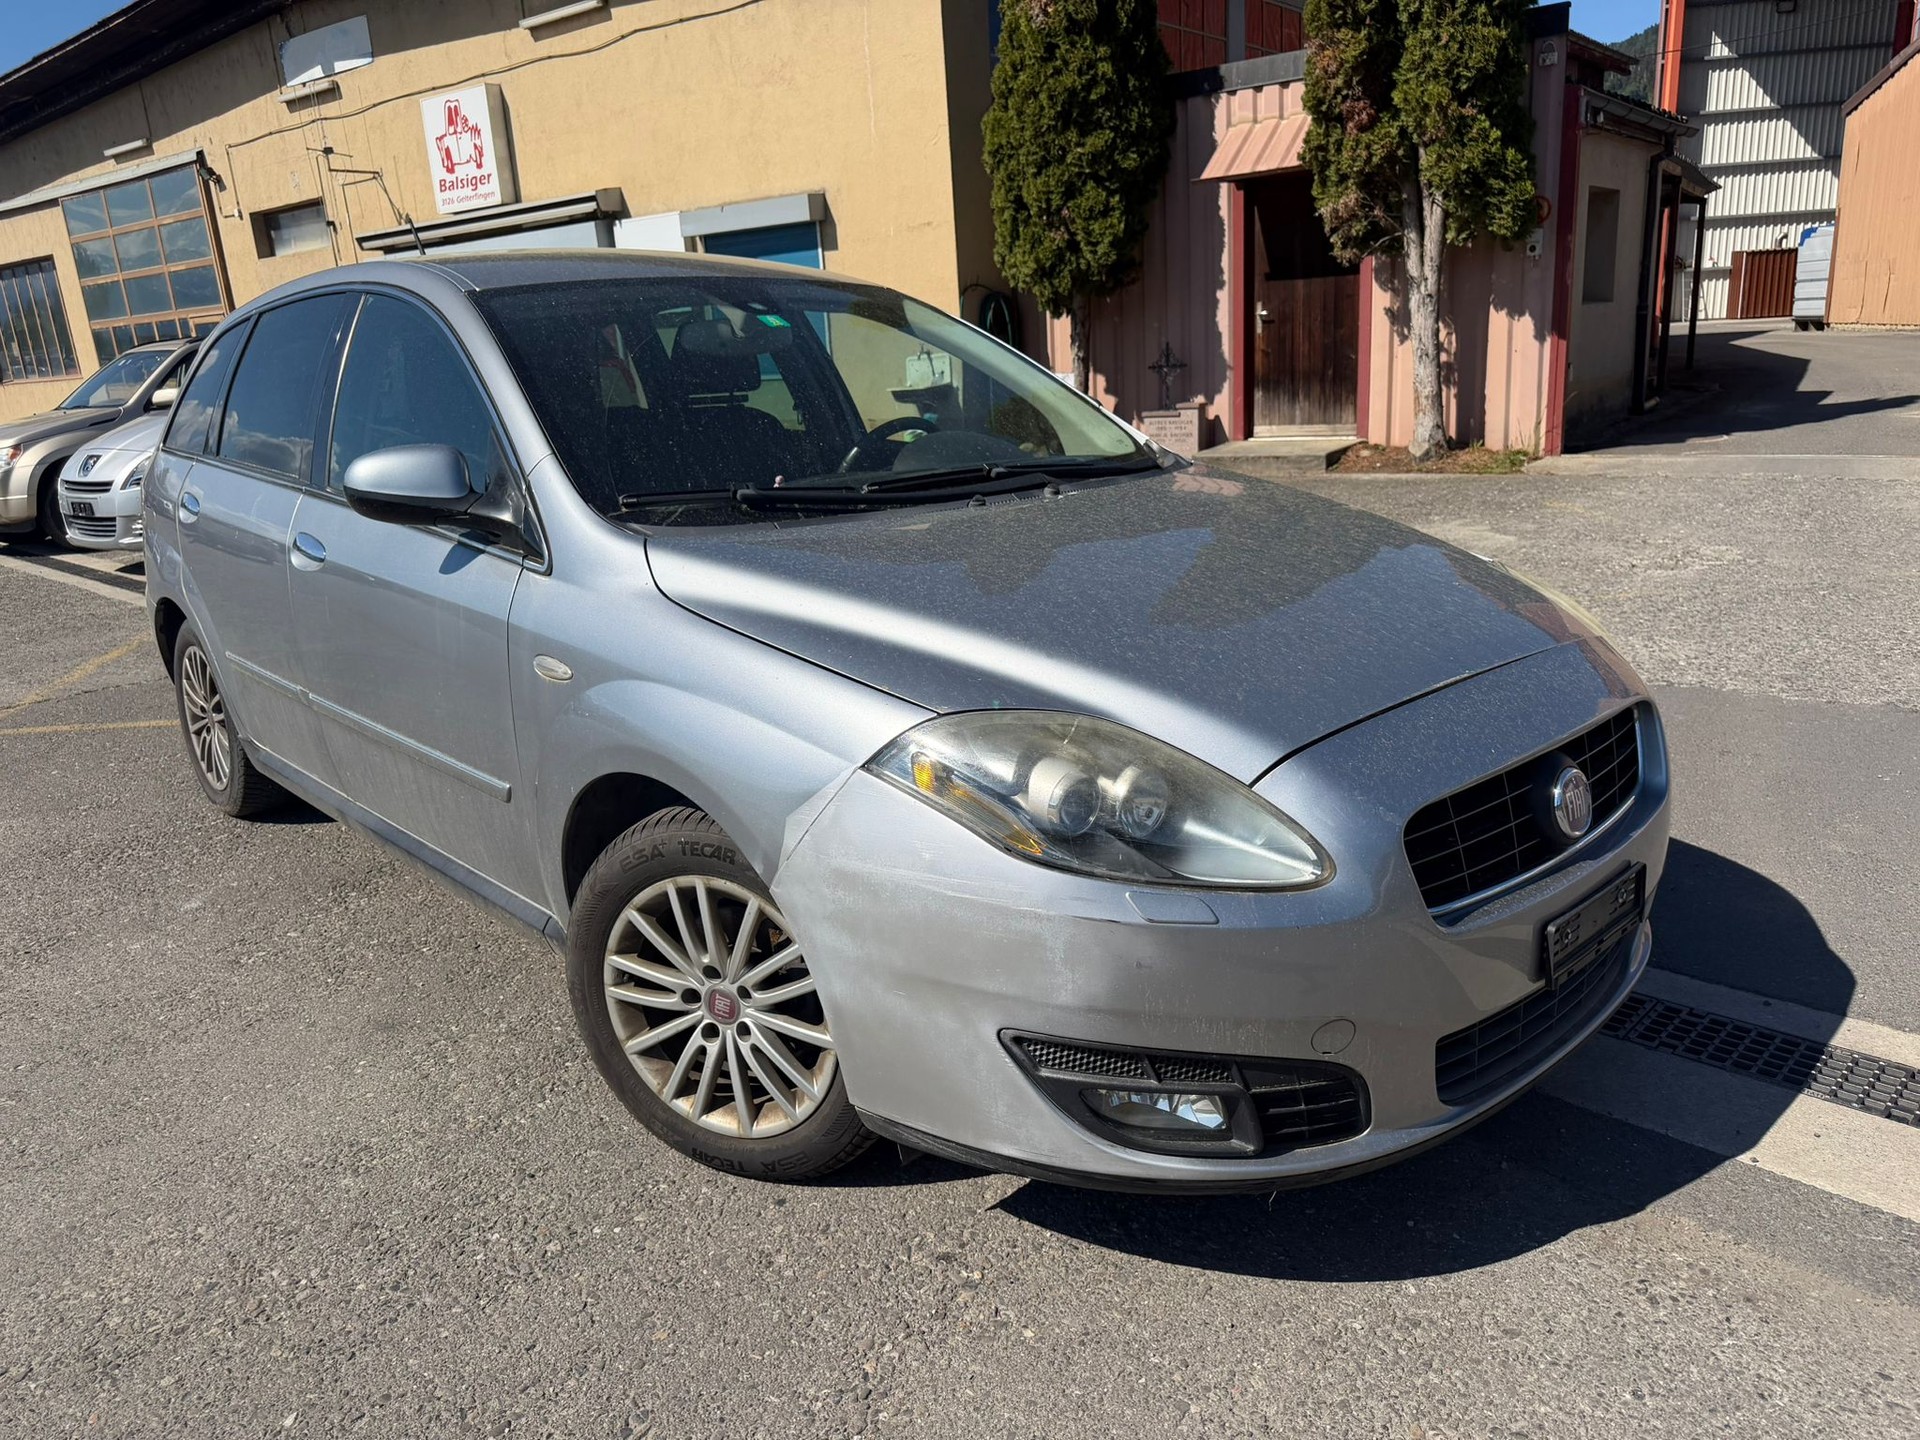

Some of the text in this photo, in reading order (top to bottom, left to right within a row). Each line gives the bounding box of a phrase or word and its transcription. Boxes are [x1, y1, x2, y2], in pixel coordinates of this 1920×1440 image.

[439, 173, 492, 192] Balsiger
[1566, 785, 1586, 821] FIAT
[677, 839, 736, 866] TECAR
[714, 993, 731, 1017] FIAT
